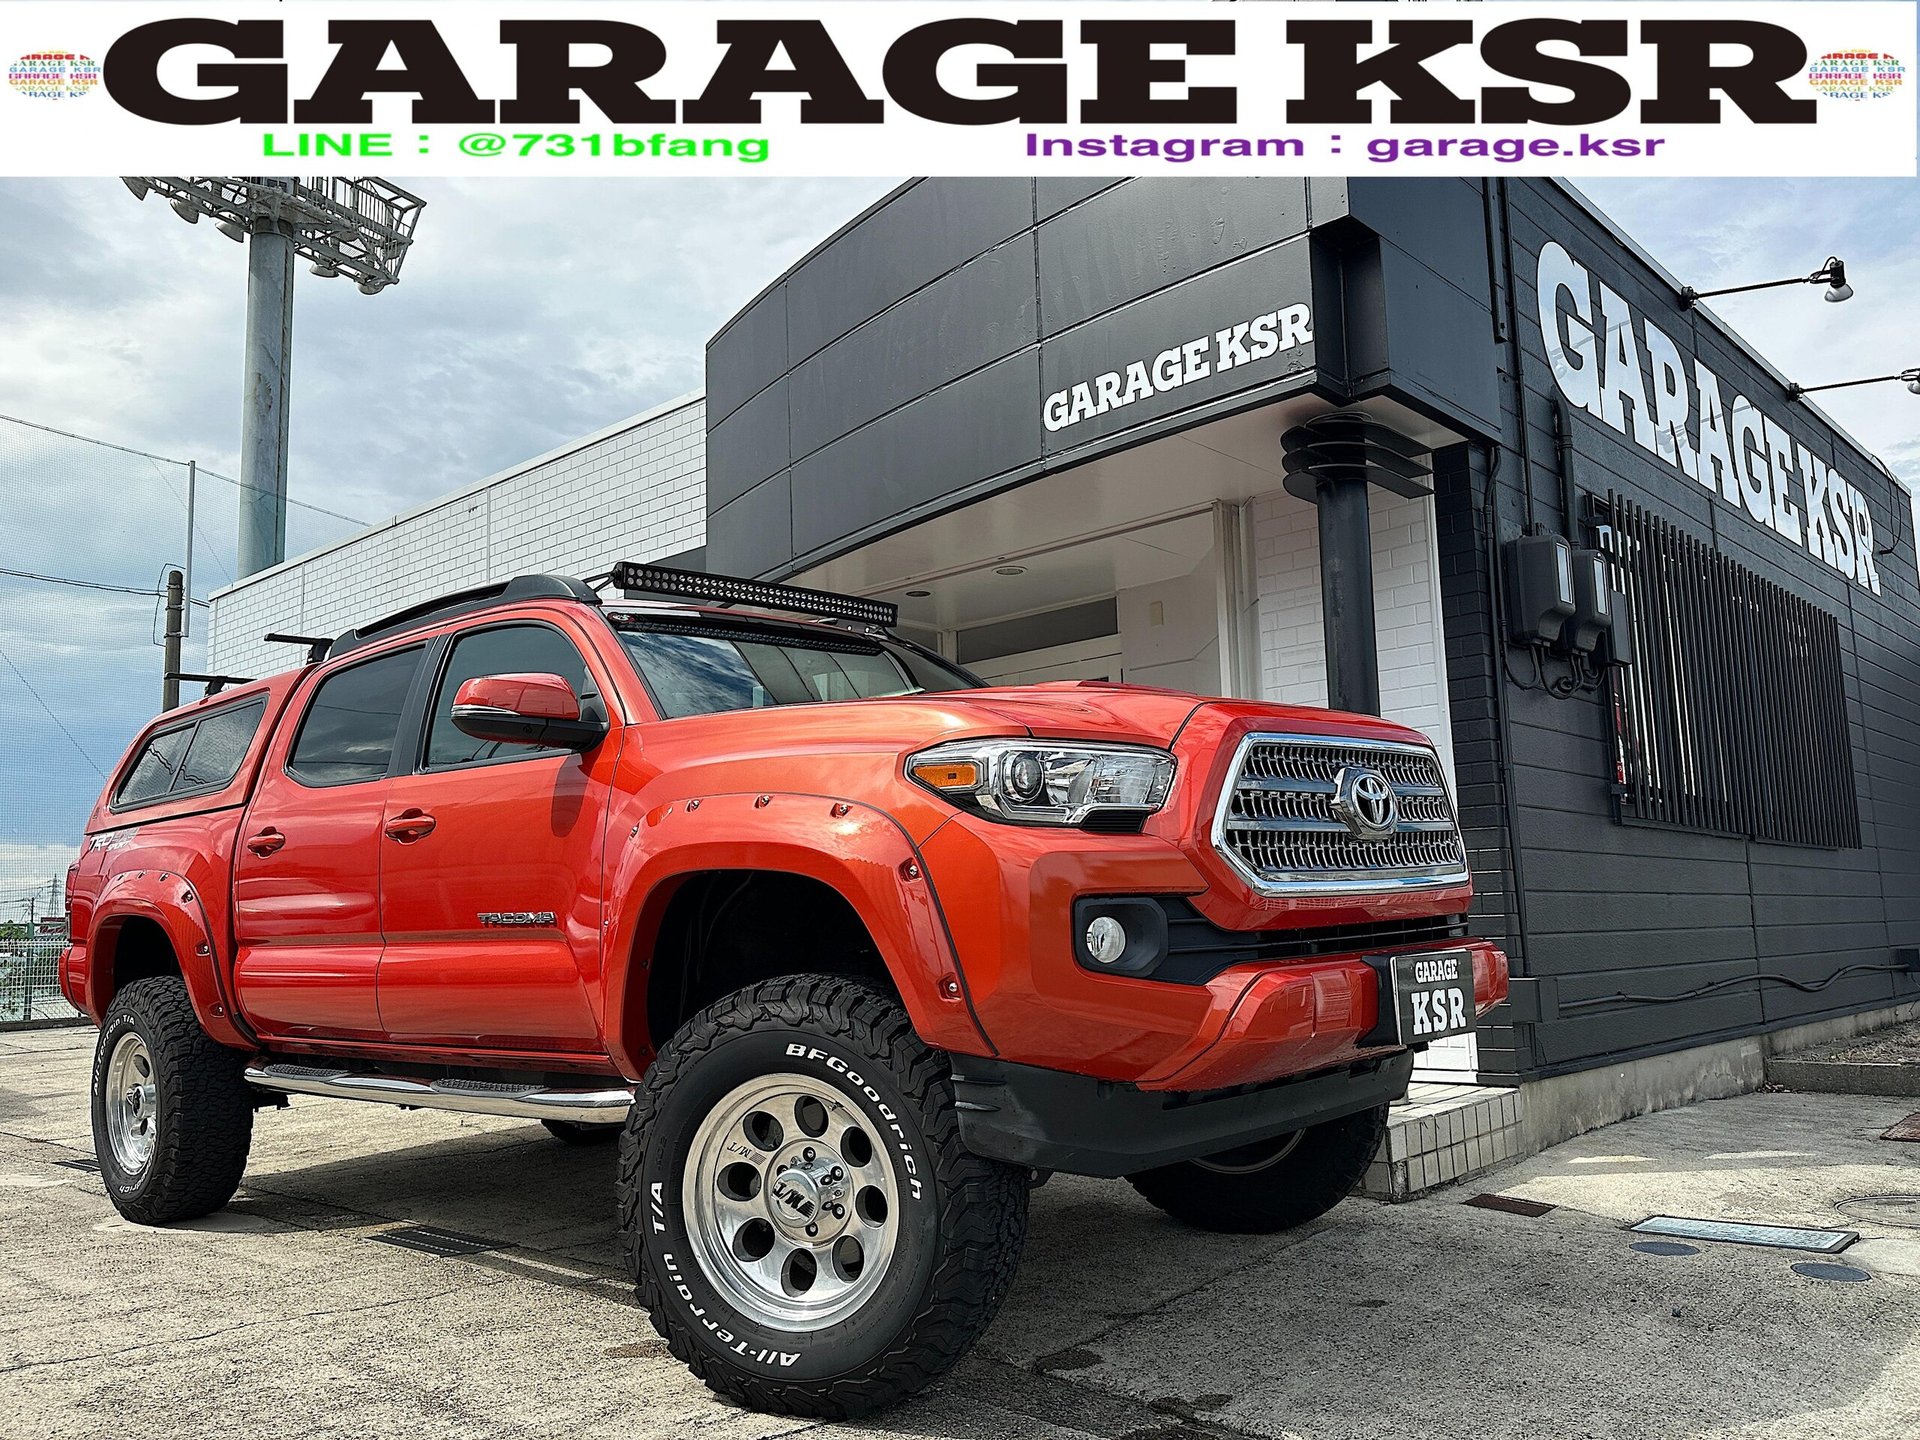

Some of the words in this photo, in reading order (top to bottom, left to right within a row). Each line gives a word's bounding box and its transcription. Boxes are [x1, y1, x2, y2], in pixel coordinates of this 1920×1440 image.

[1043, 336, 1211, 432] GARAGE
[1216, 303, 1314, 373] KSR
[1536, 241, 1803, 547] GARAGE
[1796, 442, 1881, 597] KSR
[477, 911, 557, 925] TACOMA
[1415, 959, 1459, 983] GARAGE
[122, 1014, 135, 1026] T/A
[1411, 987, 1467, 1035] KSR
[786, 1043, 923, 1200] BFGoodrich
[727, 1142, 752, 1158] M/T
[651, 1182, 667, 1235] T/A
[773, 1182, 805, 1209] M/T
[663, 1253, 802, 1367] All-Terrain
